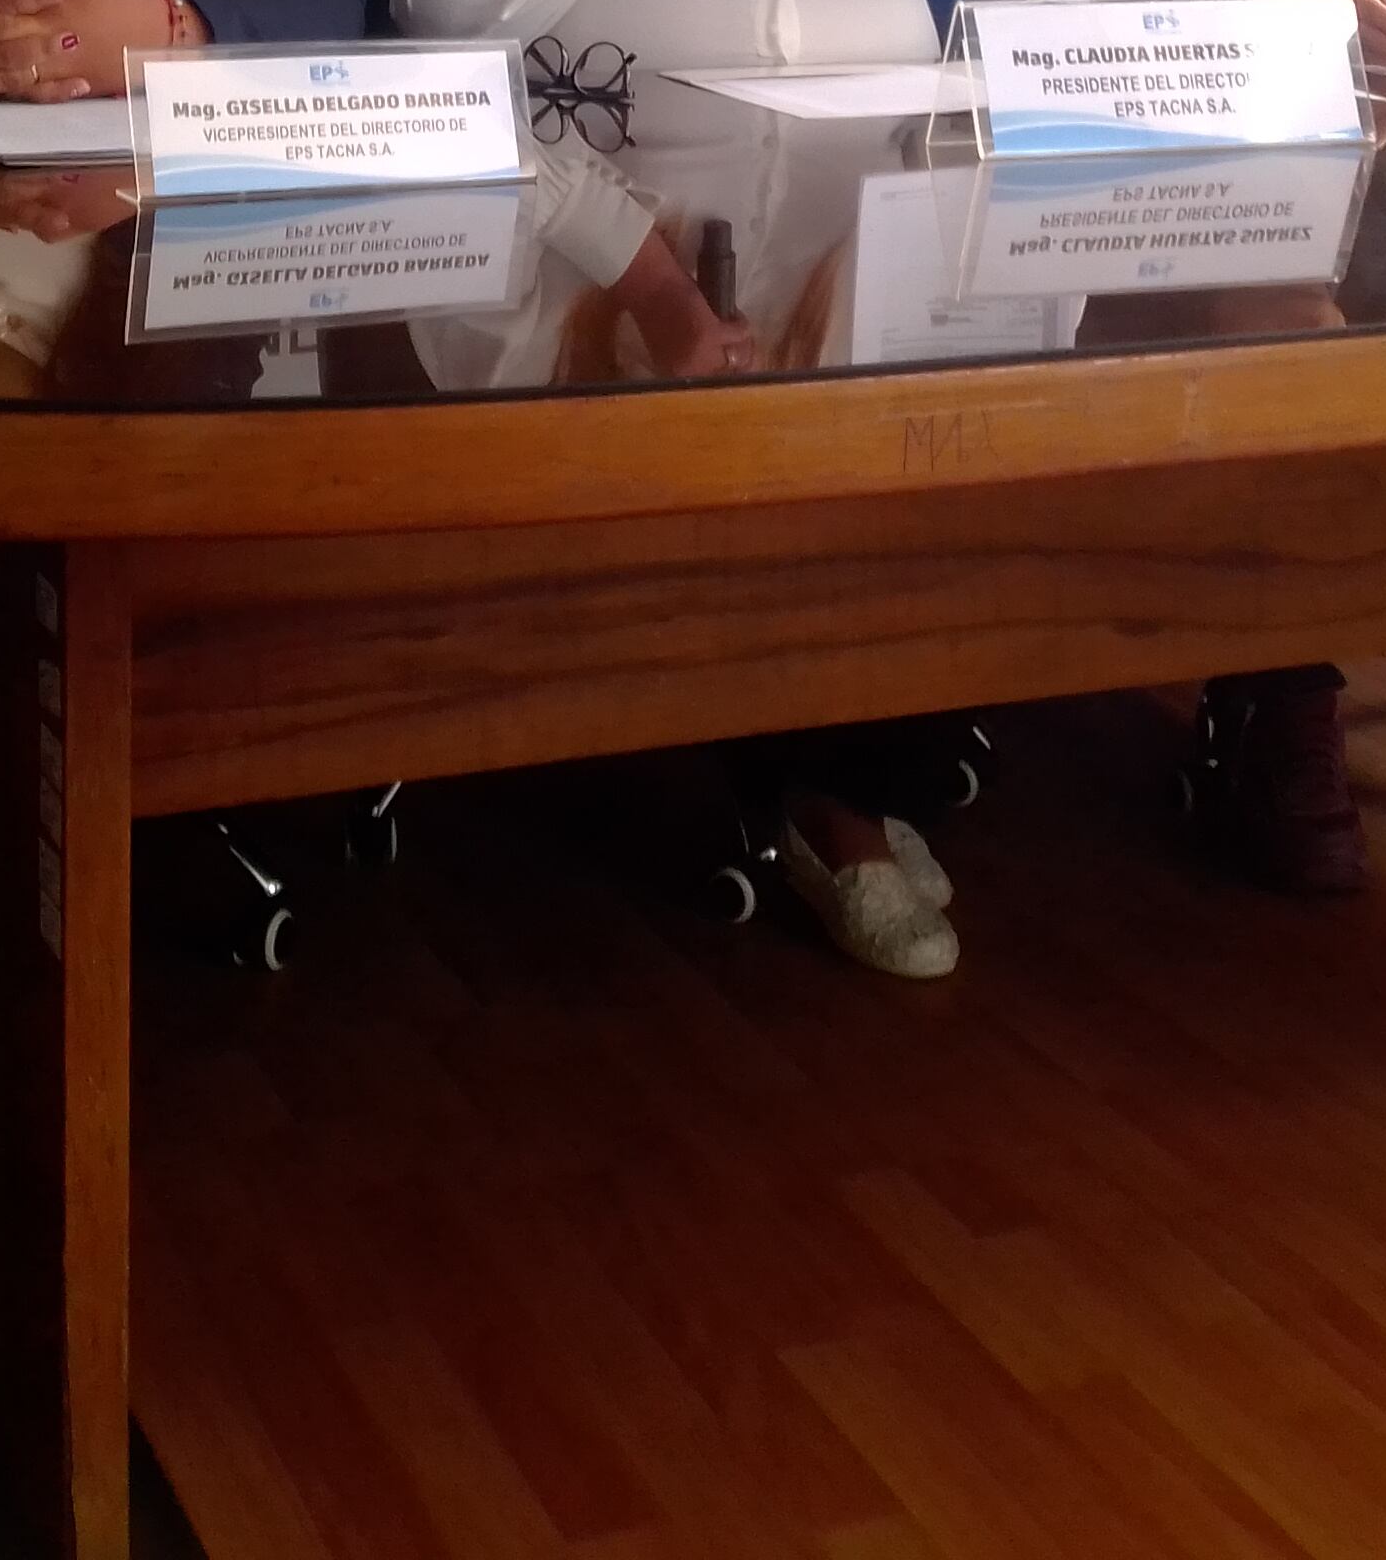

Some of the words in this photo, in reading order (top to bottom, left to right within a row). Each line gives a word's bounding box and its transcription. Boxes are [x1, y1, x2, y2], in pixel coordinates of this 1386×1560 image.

[1013, 49, 1060, 70] Mag.
[1065, 46, 1150, 64] CLAUDIA
[1154, 43, 1240, 61] HUERTAS
[1042, 76, 1141, 95] PRESIDENTE
[1144, 75, 1175, 90] DEL
[1179, 72, 1251, 89] DIRECTO
[173, 102, 221, 122] Mag.
[226, 98, 307, 116] GISELLA
[313, 95, 399, 113] DELGADO
[405, 91, 491, 109] BARREDA
[1114, 101, 1145, 117] EPS
[1150, 100, 1203, 116] TACNA
[1207, 98, 1236, 114] S.A.
[203, 123, 327, 143] VICEPRESIDENTE
[331, 122, 358, 137] DEL
[362, 118, 445, 136] DIRECTORIO
[450, 118, 467, 131] DE
[285, 146, 313, 160] EPS
[317, 144, 366, 159] TACNA
[369, 142, 395, 157] S.A.
